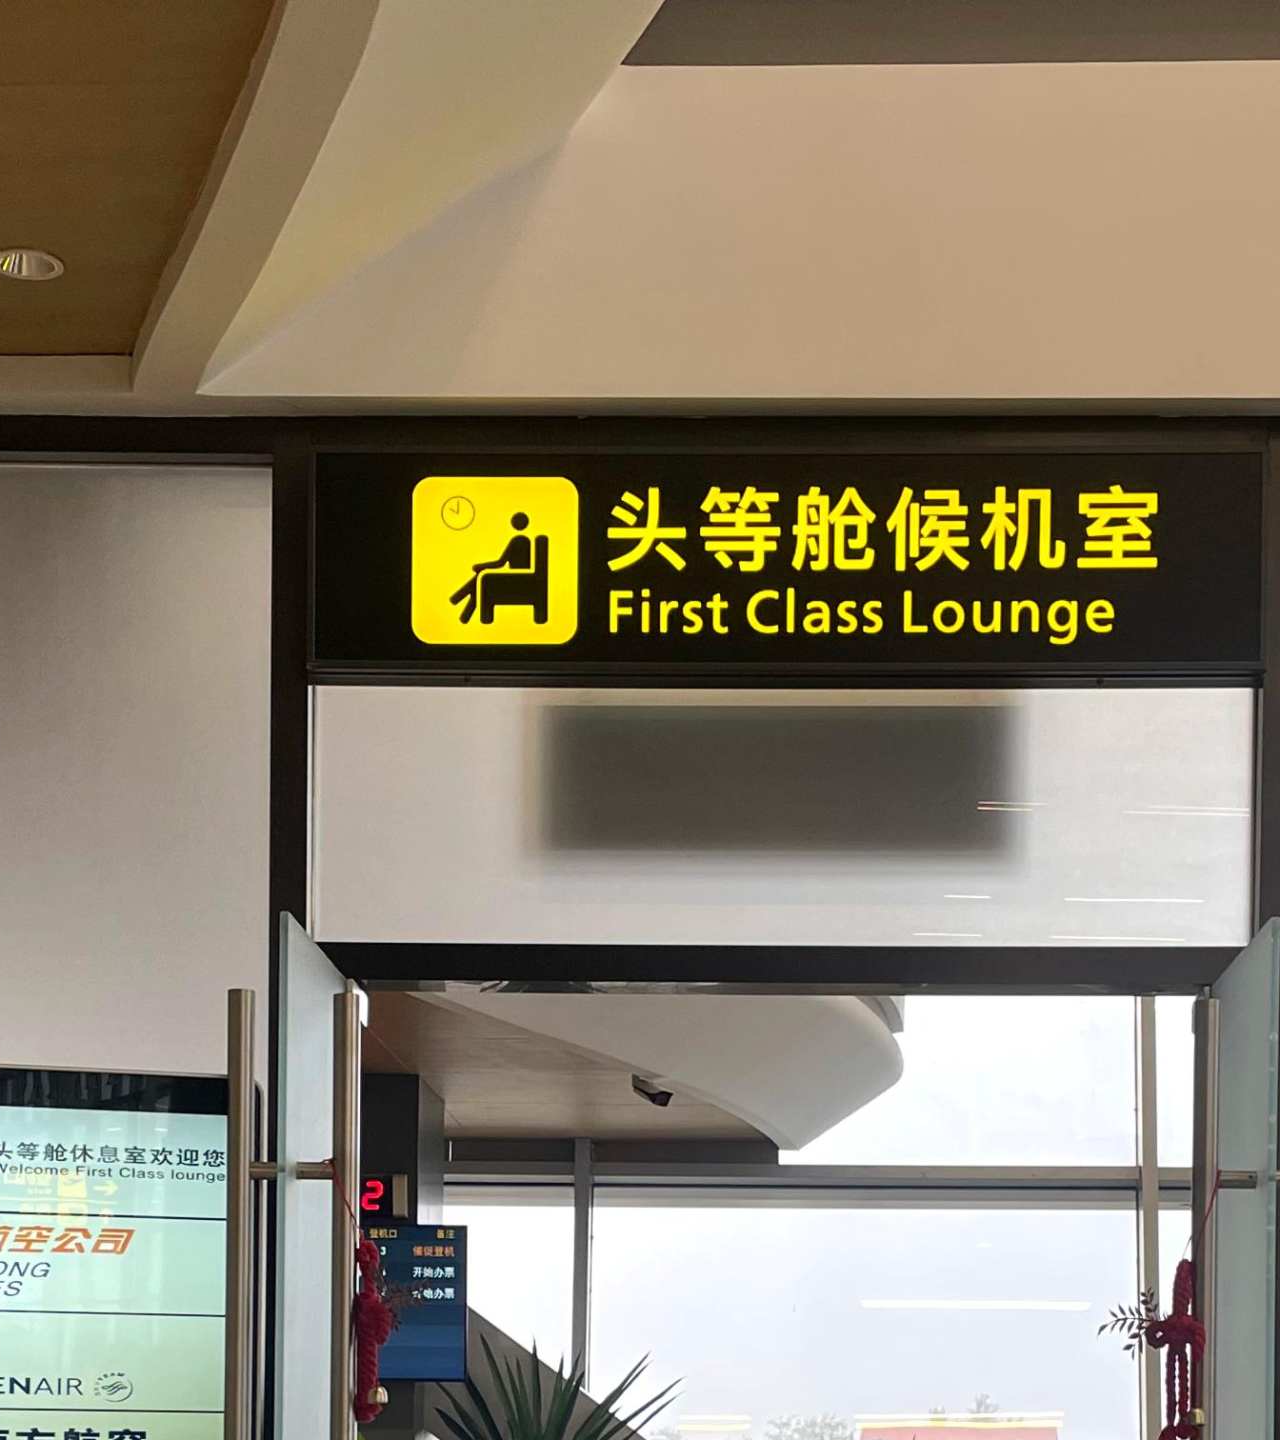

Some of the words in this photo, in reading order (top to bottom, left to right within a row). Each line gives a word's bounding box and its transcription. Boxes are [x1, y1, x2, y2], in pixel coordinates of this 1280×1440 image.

[606, 485, 1159, 573] 头等舱候机室
[608, 588, 729, 634] First
[746, 588, 883, 634] Class
[903, 590, 1116, 645] Lounge
[76, 1165, 112, 1178] First
[119, 1167, 164, 1180] Class
[171, 1169, 225, 1183] lounge
